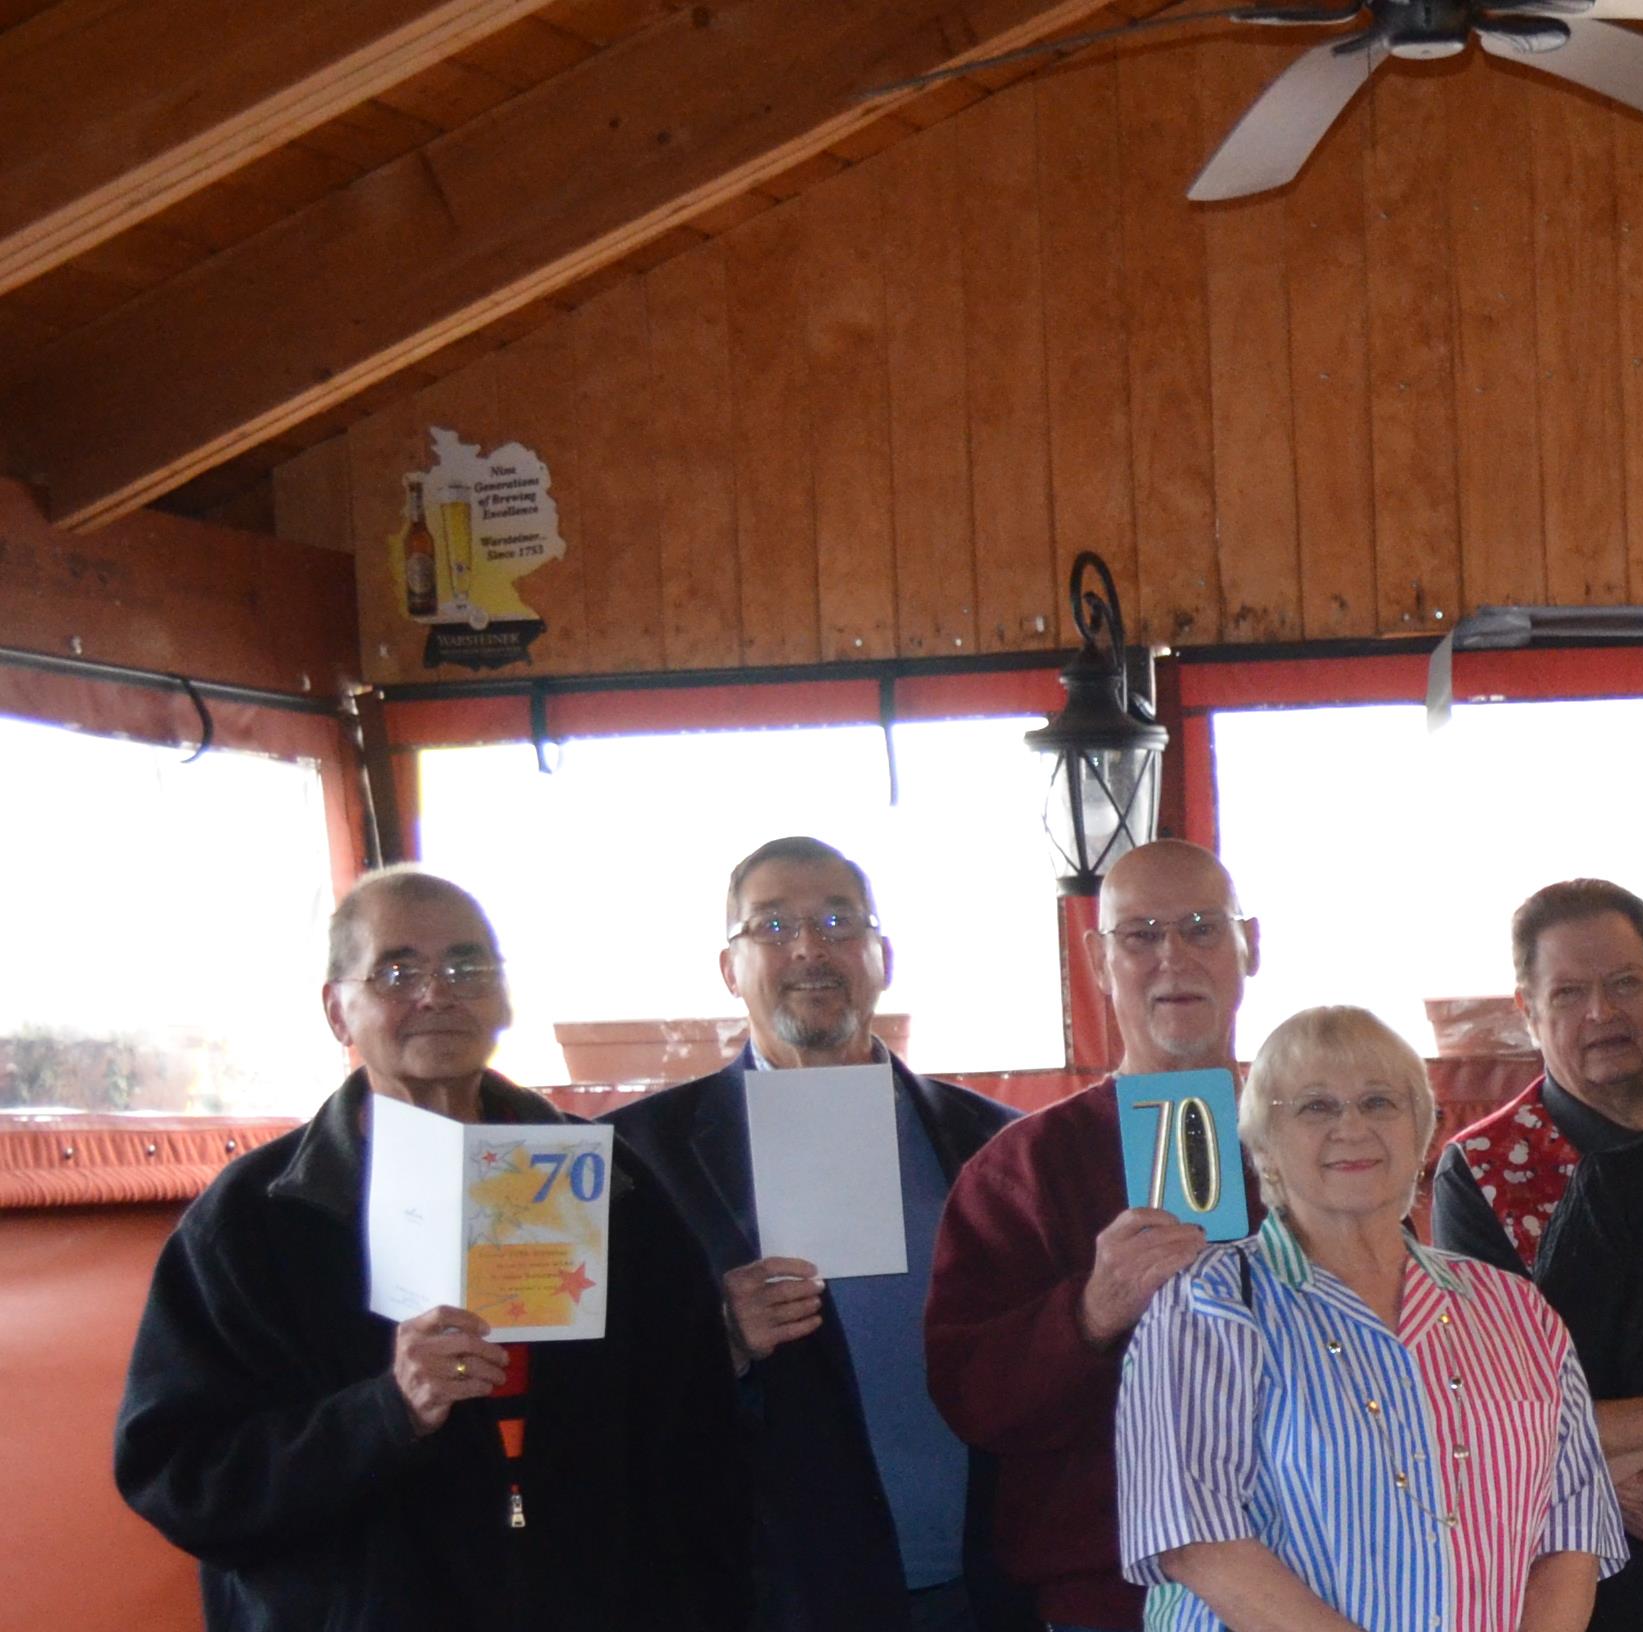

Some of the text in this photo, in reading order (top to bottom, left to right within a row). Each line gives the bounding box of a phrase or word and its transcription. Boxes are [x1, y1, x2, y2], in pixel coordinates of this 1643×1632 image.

[474, 478, 540, 493] Generations
[492, 493, 537, 505] Brewing
[483, 506, 539, 520] Excellence
[1132, 1097, 1221, 1213] 70
[529, 1152, 606, 1203] 70
